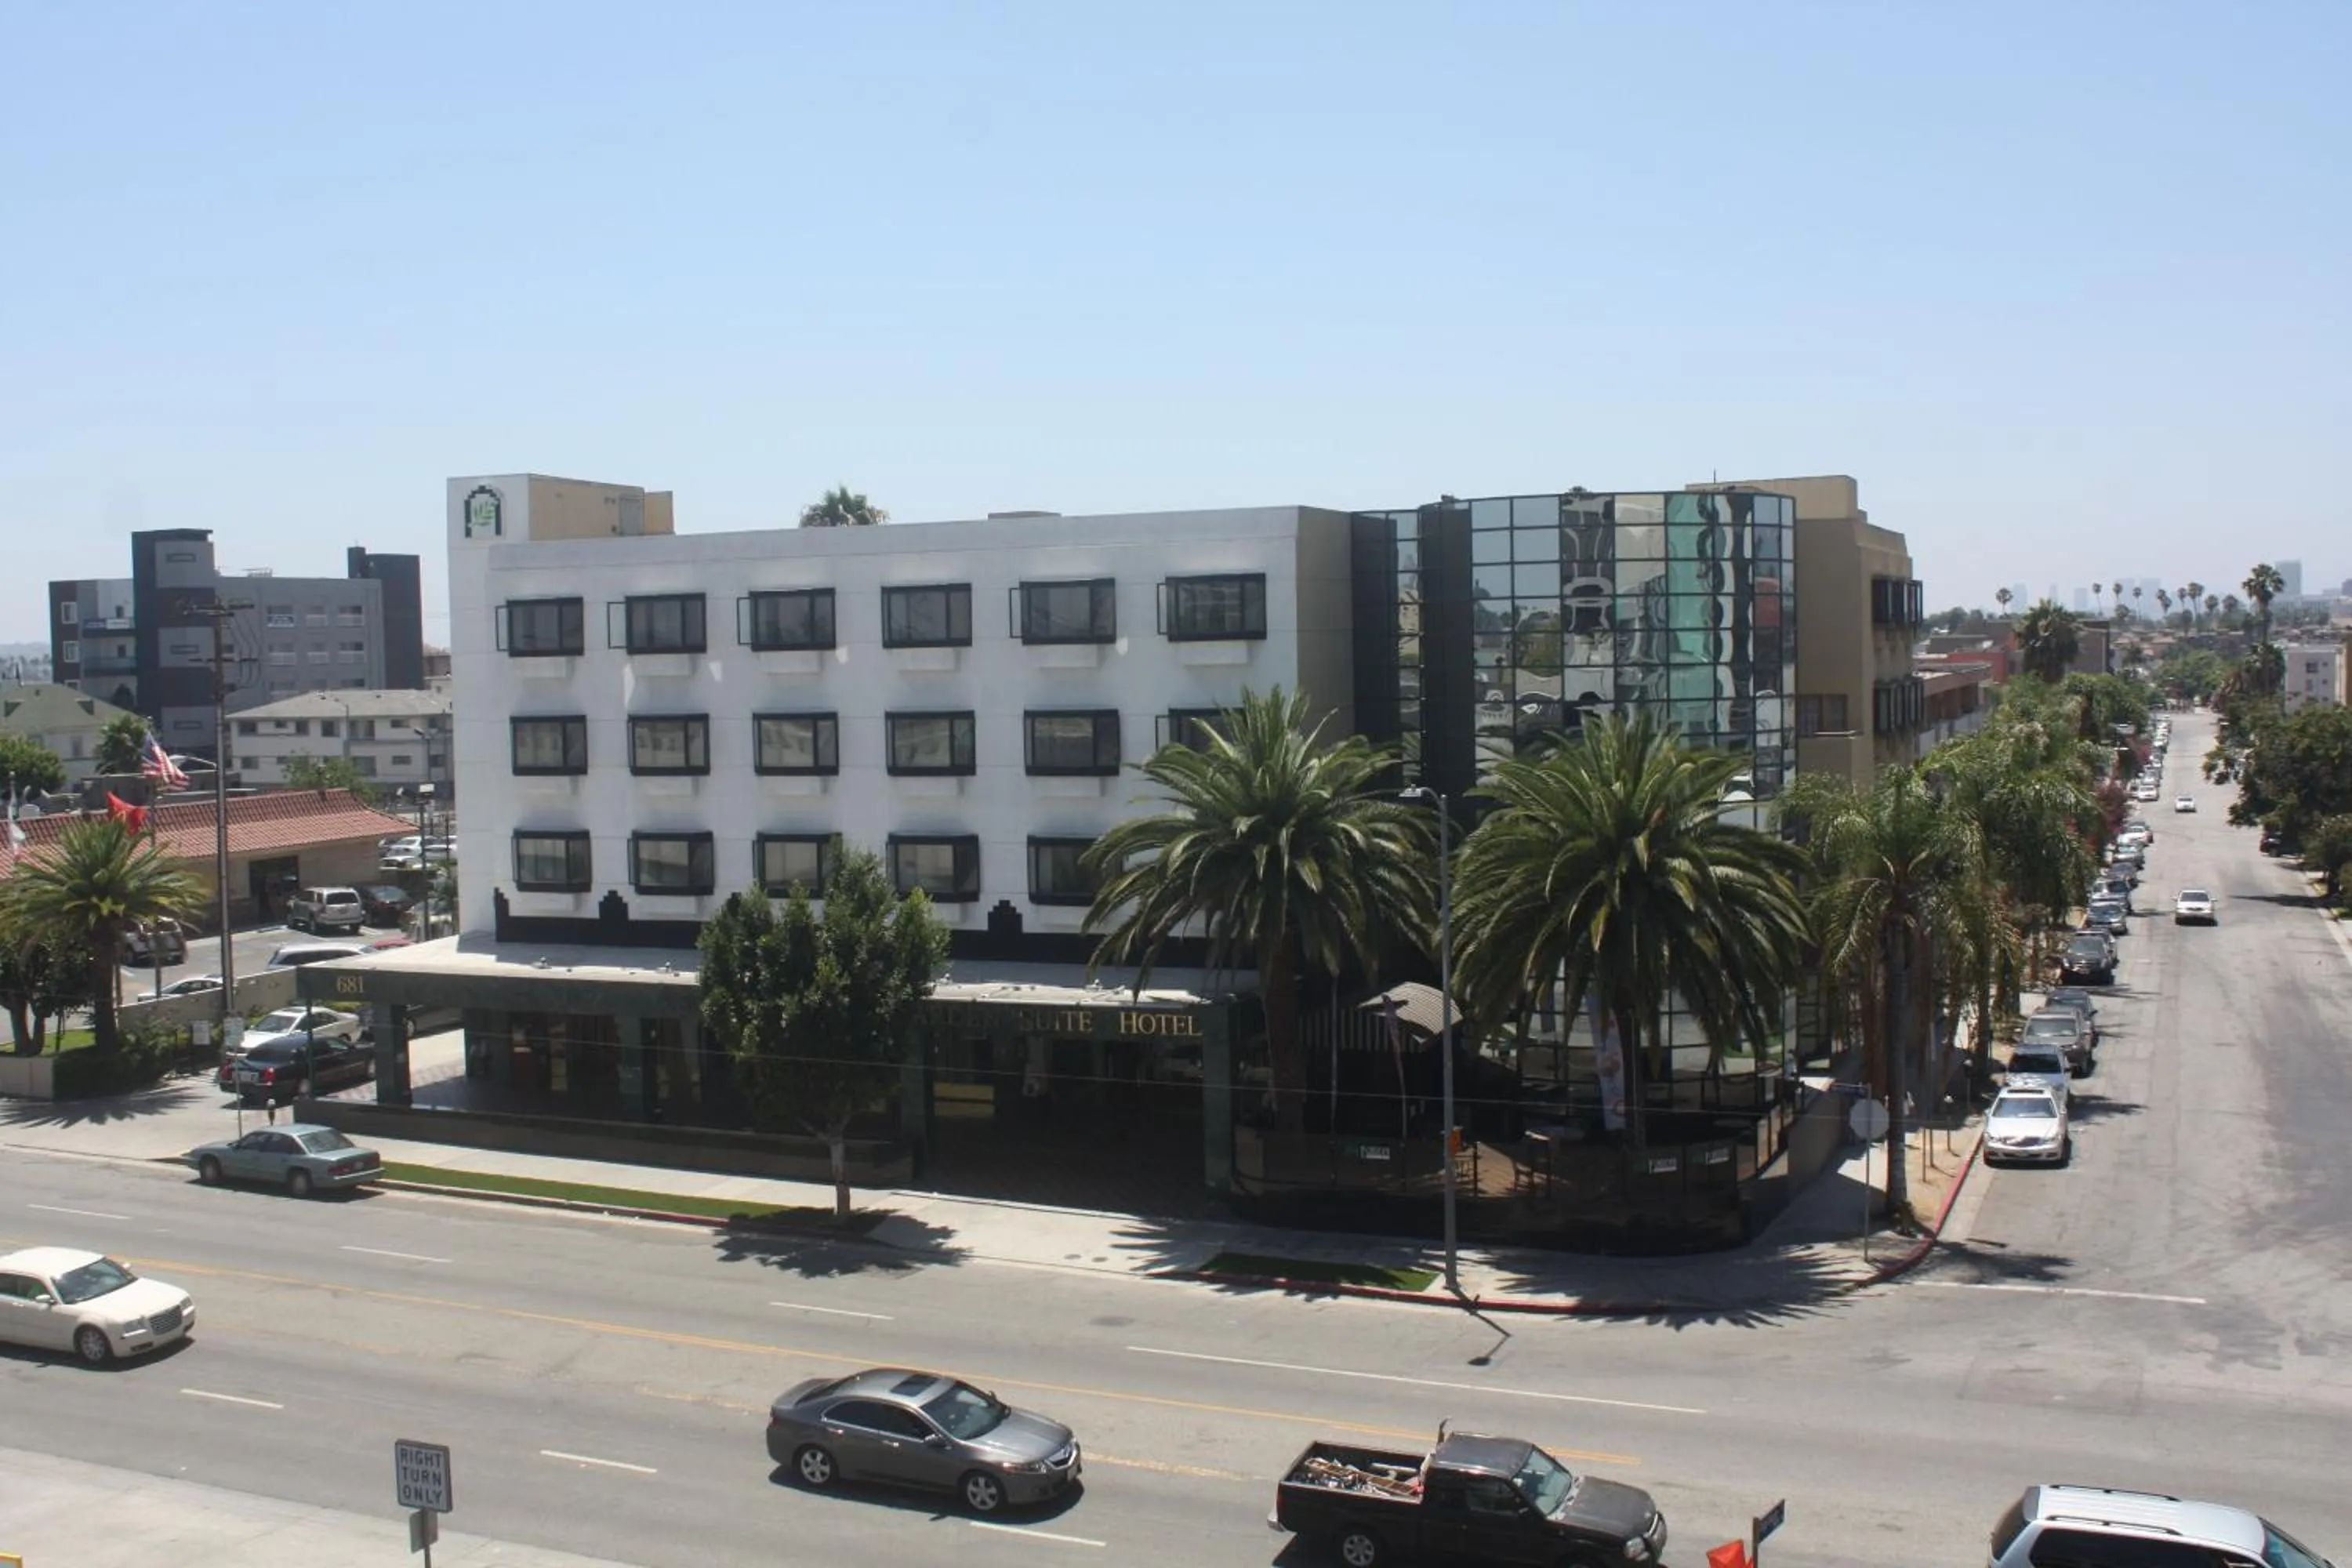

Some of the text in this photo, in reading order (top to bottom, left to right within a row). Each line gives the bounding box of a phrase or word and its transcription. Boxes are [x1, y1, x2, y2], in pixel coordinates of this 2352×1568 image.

[337, 975, 364, 993] 681
[1019, 1008, 1093, 1033] SUITE
[1119, 1011, 1204, 1036] HOTEL
[400, 1447, 442, 1468] RIGHT
[401, 1466, 442, 1487] TURN
[402, 1484, 443, 1504] ONLY
